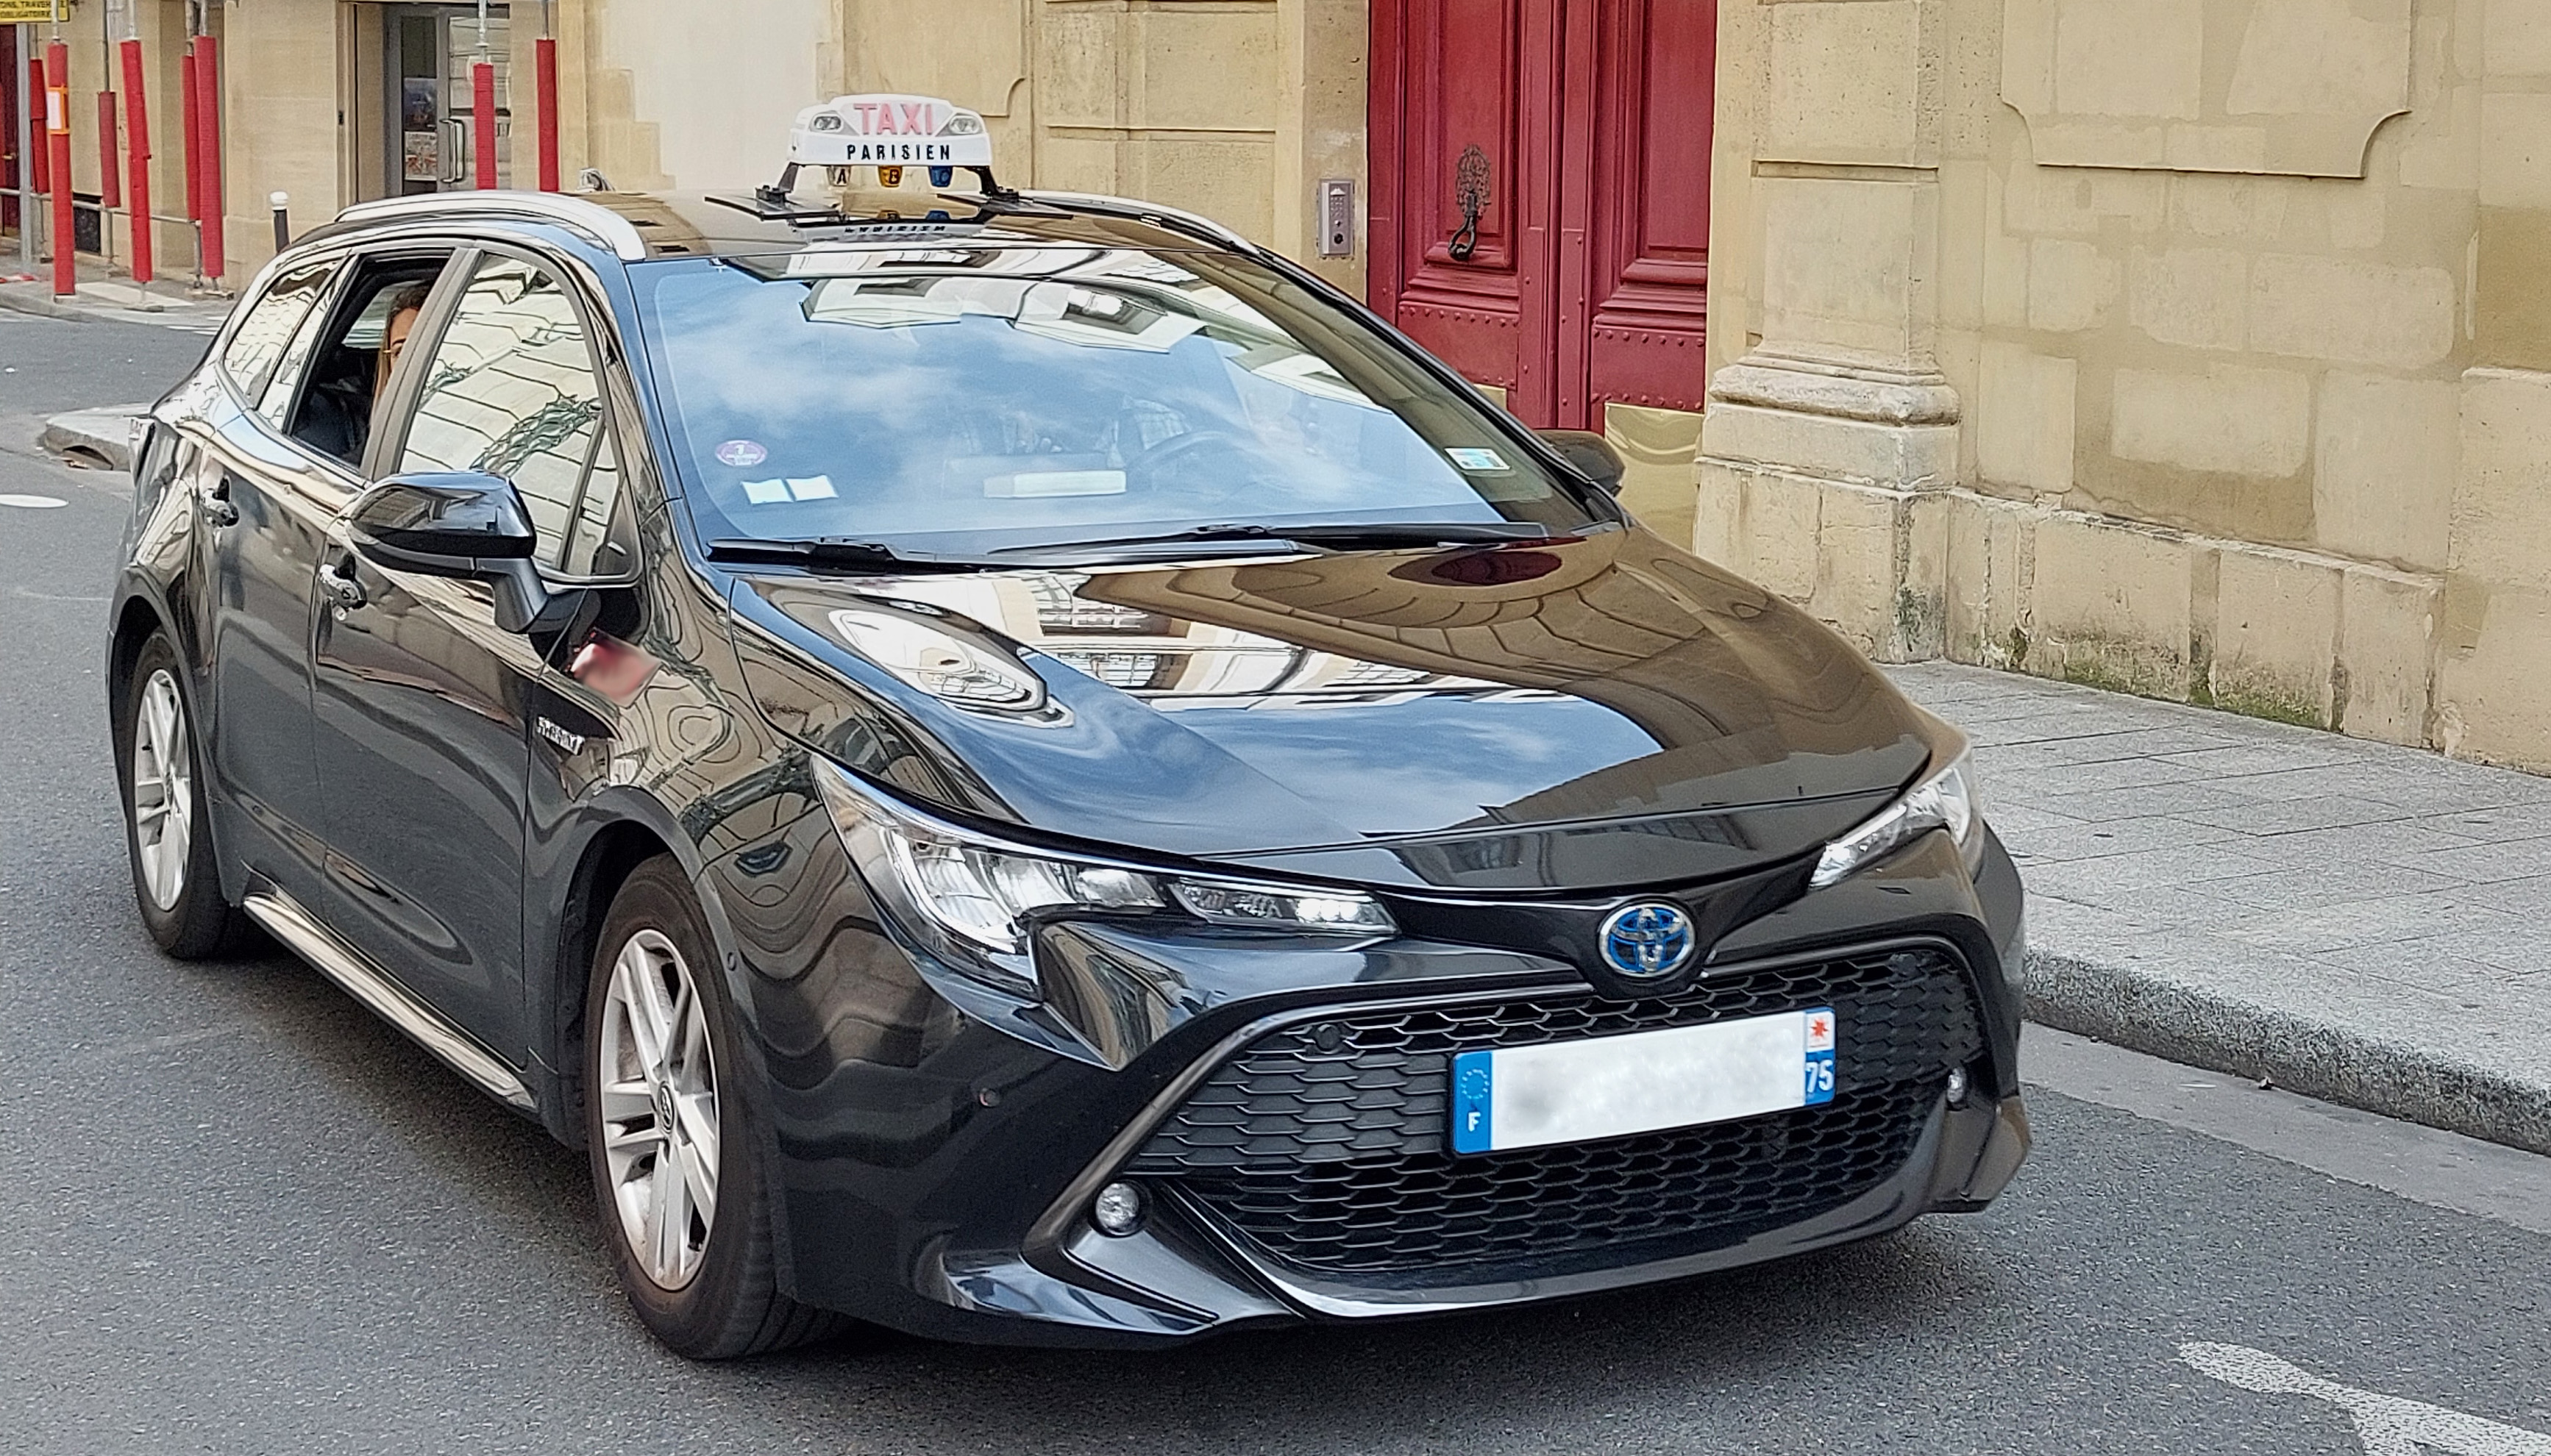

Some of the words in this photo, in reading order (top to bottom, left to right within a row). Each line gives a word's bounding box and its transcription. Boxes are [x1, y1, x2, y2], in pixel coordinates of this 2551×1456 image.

[854, 103, 933, 135] TAXI
[847, 144, 950, 161] PARISIEN
[836, 168, 847, 185] A
[889, 169, 900, 185] B
[1805, 1059, 1833, 1093] 75
[1467, 1112, 1481, 1132] F
